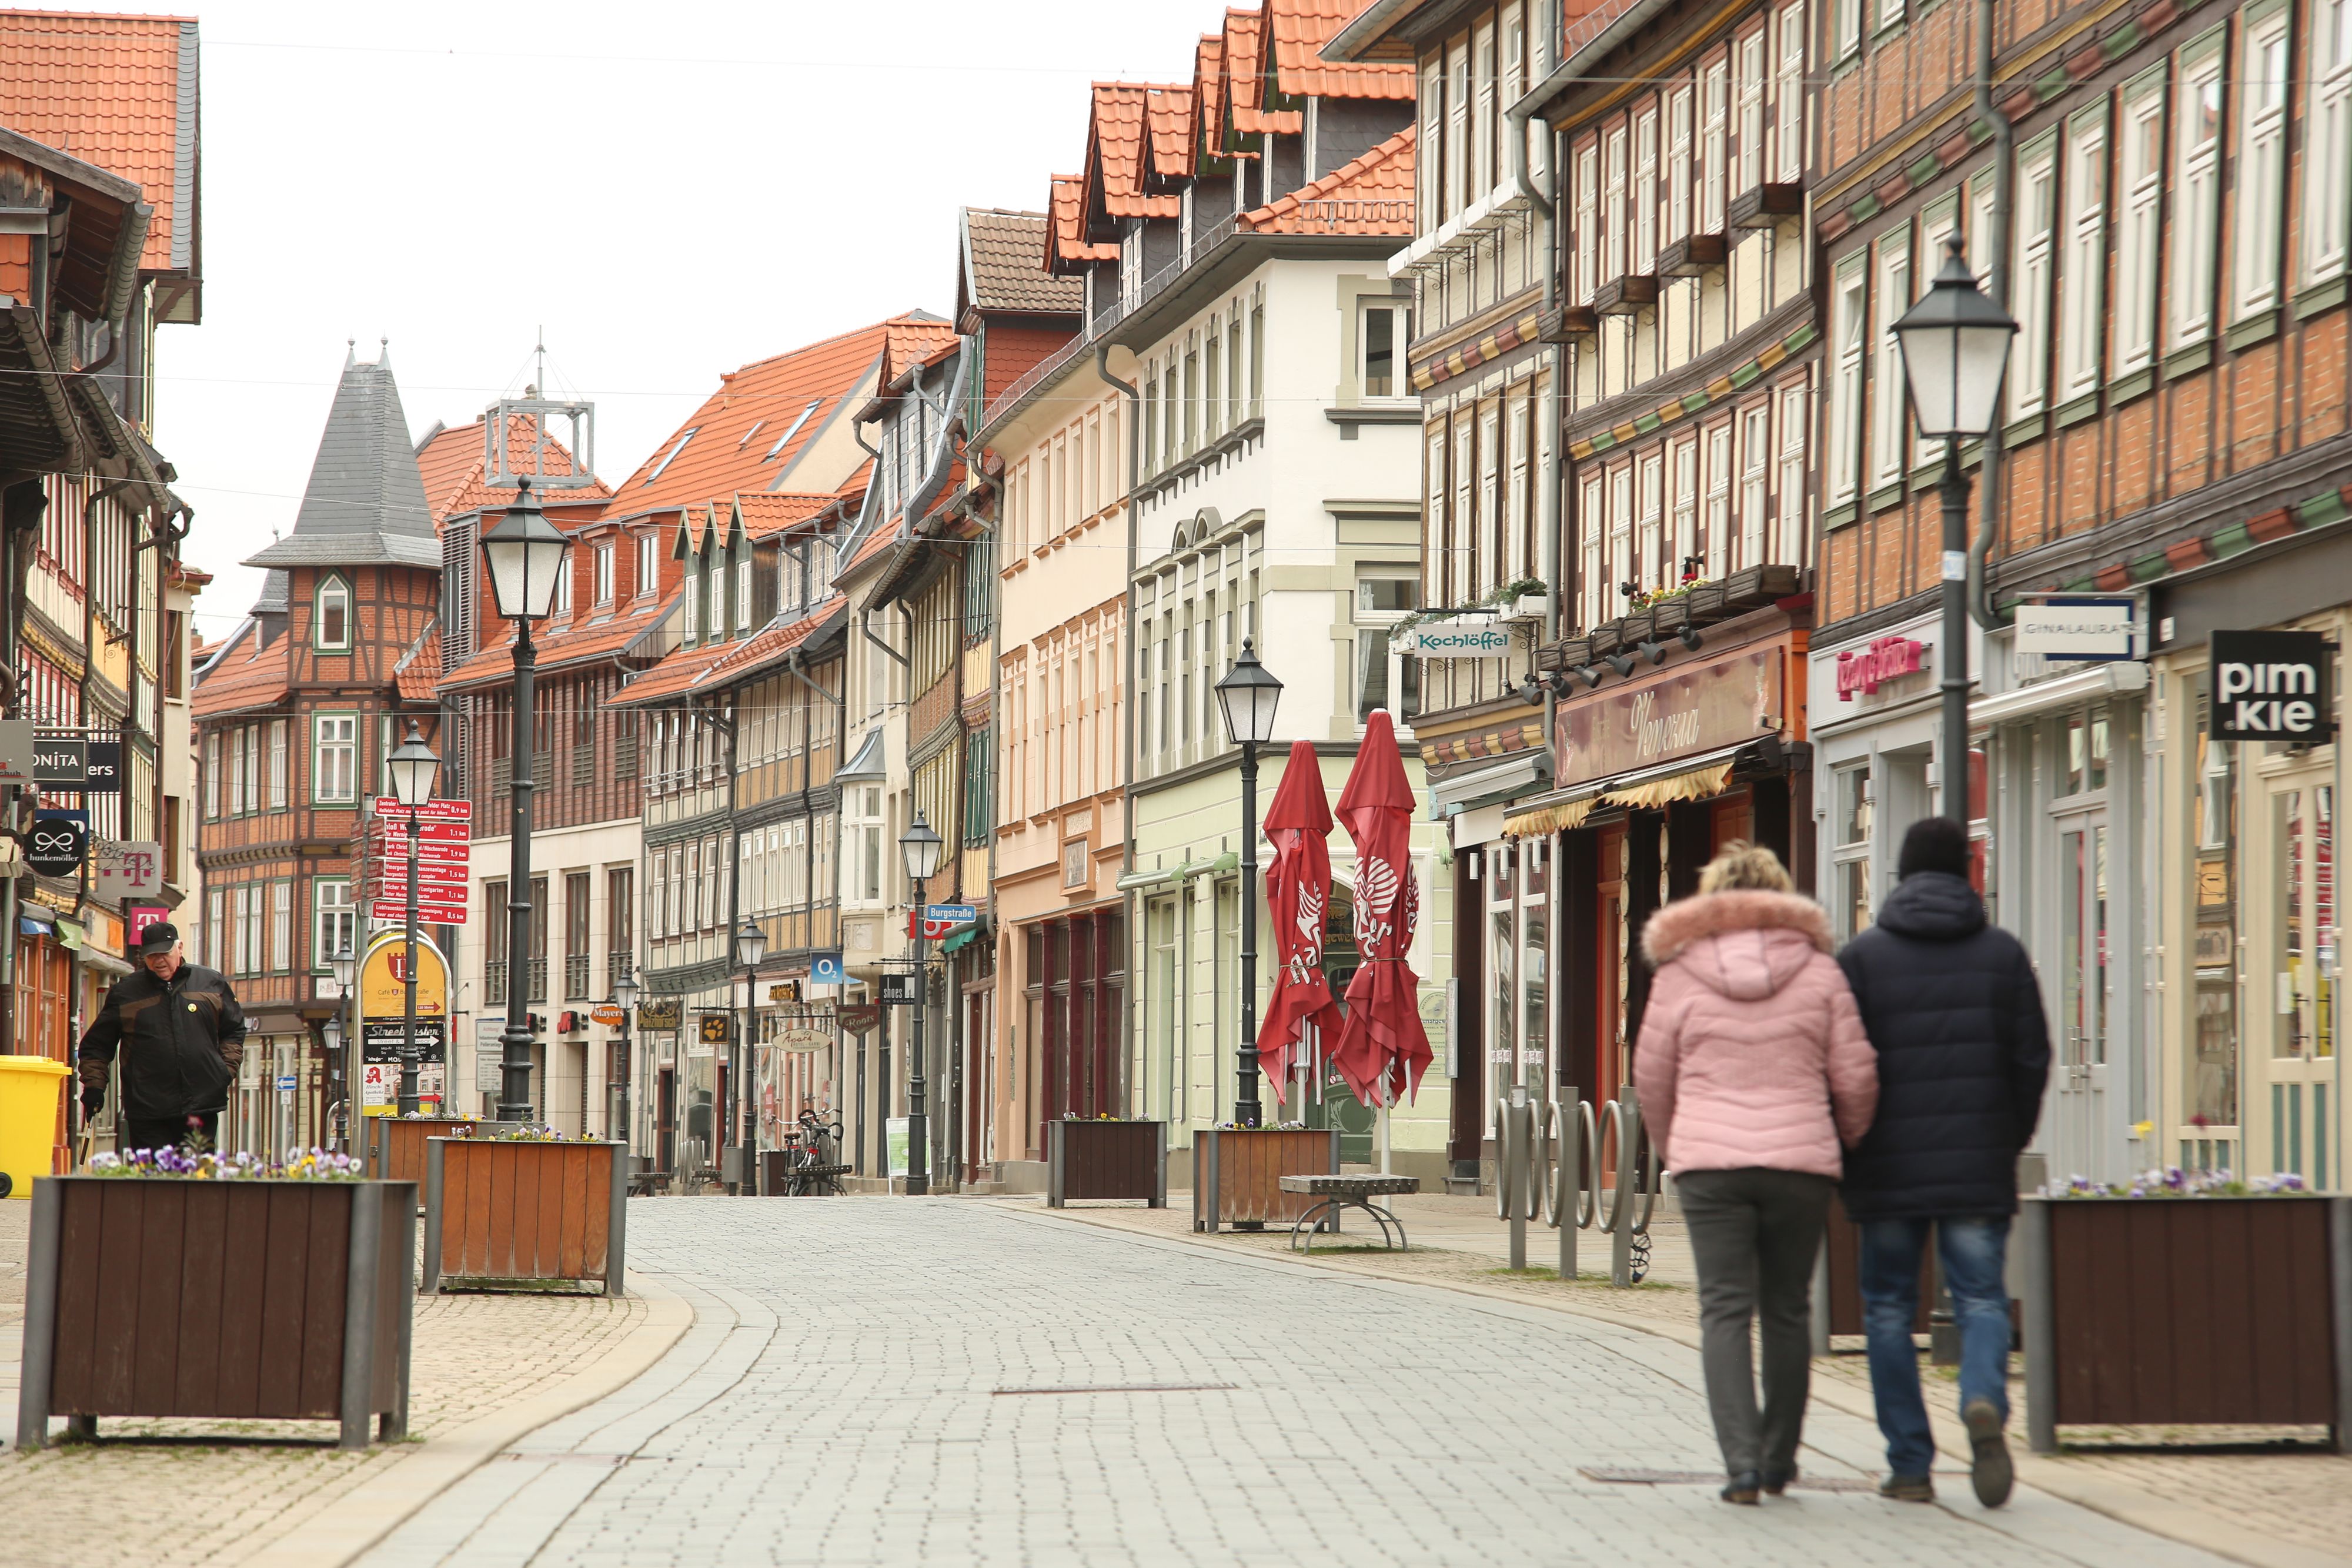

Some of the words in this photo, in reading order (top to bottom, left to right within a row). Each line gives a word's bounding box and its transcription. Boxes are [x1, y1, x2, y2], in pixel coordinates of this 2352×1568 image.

[2024, 623, 2120, 634] GINALAURA
[1418, 631, 1508, 650] Kochlöffel
[2218, 662, 2317, 704] pim
[1631, 687, 1699, 761] Venezia
[33, 751, 78, 770] ONITA
[29, 854, 79, 862] hunkemöller
[931, 908, 972, 919] Burgstraße
[883, 977, 903, 998] shoes
[845, 1015, 874, 1029] Roots
[783, 1032, 813, 1048] Apart
